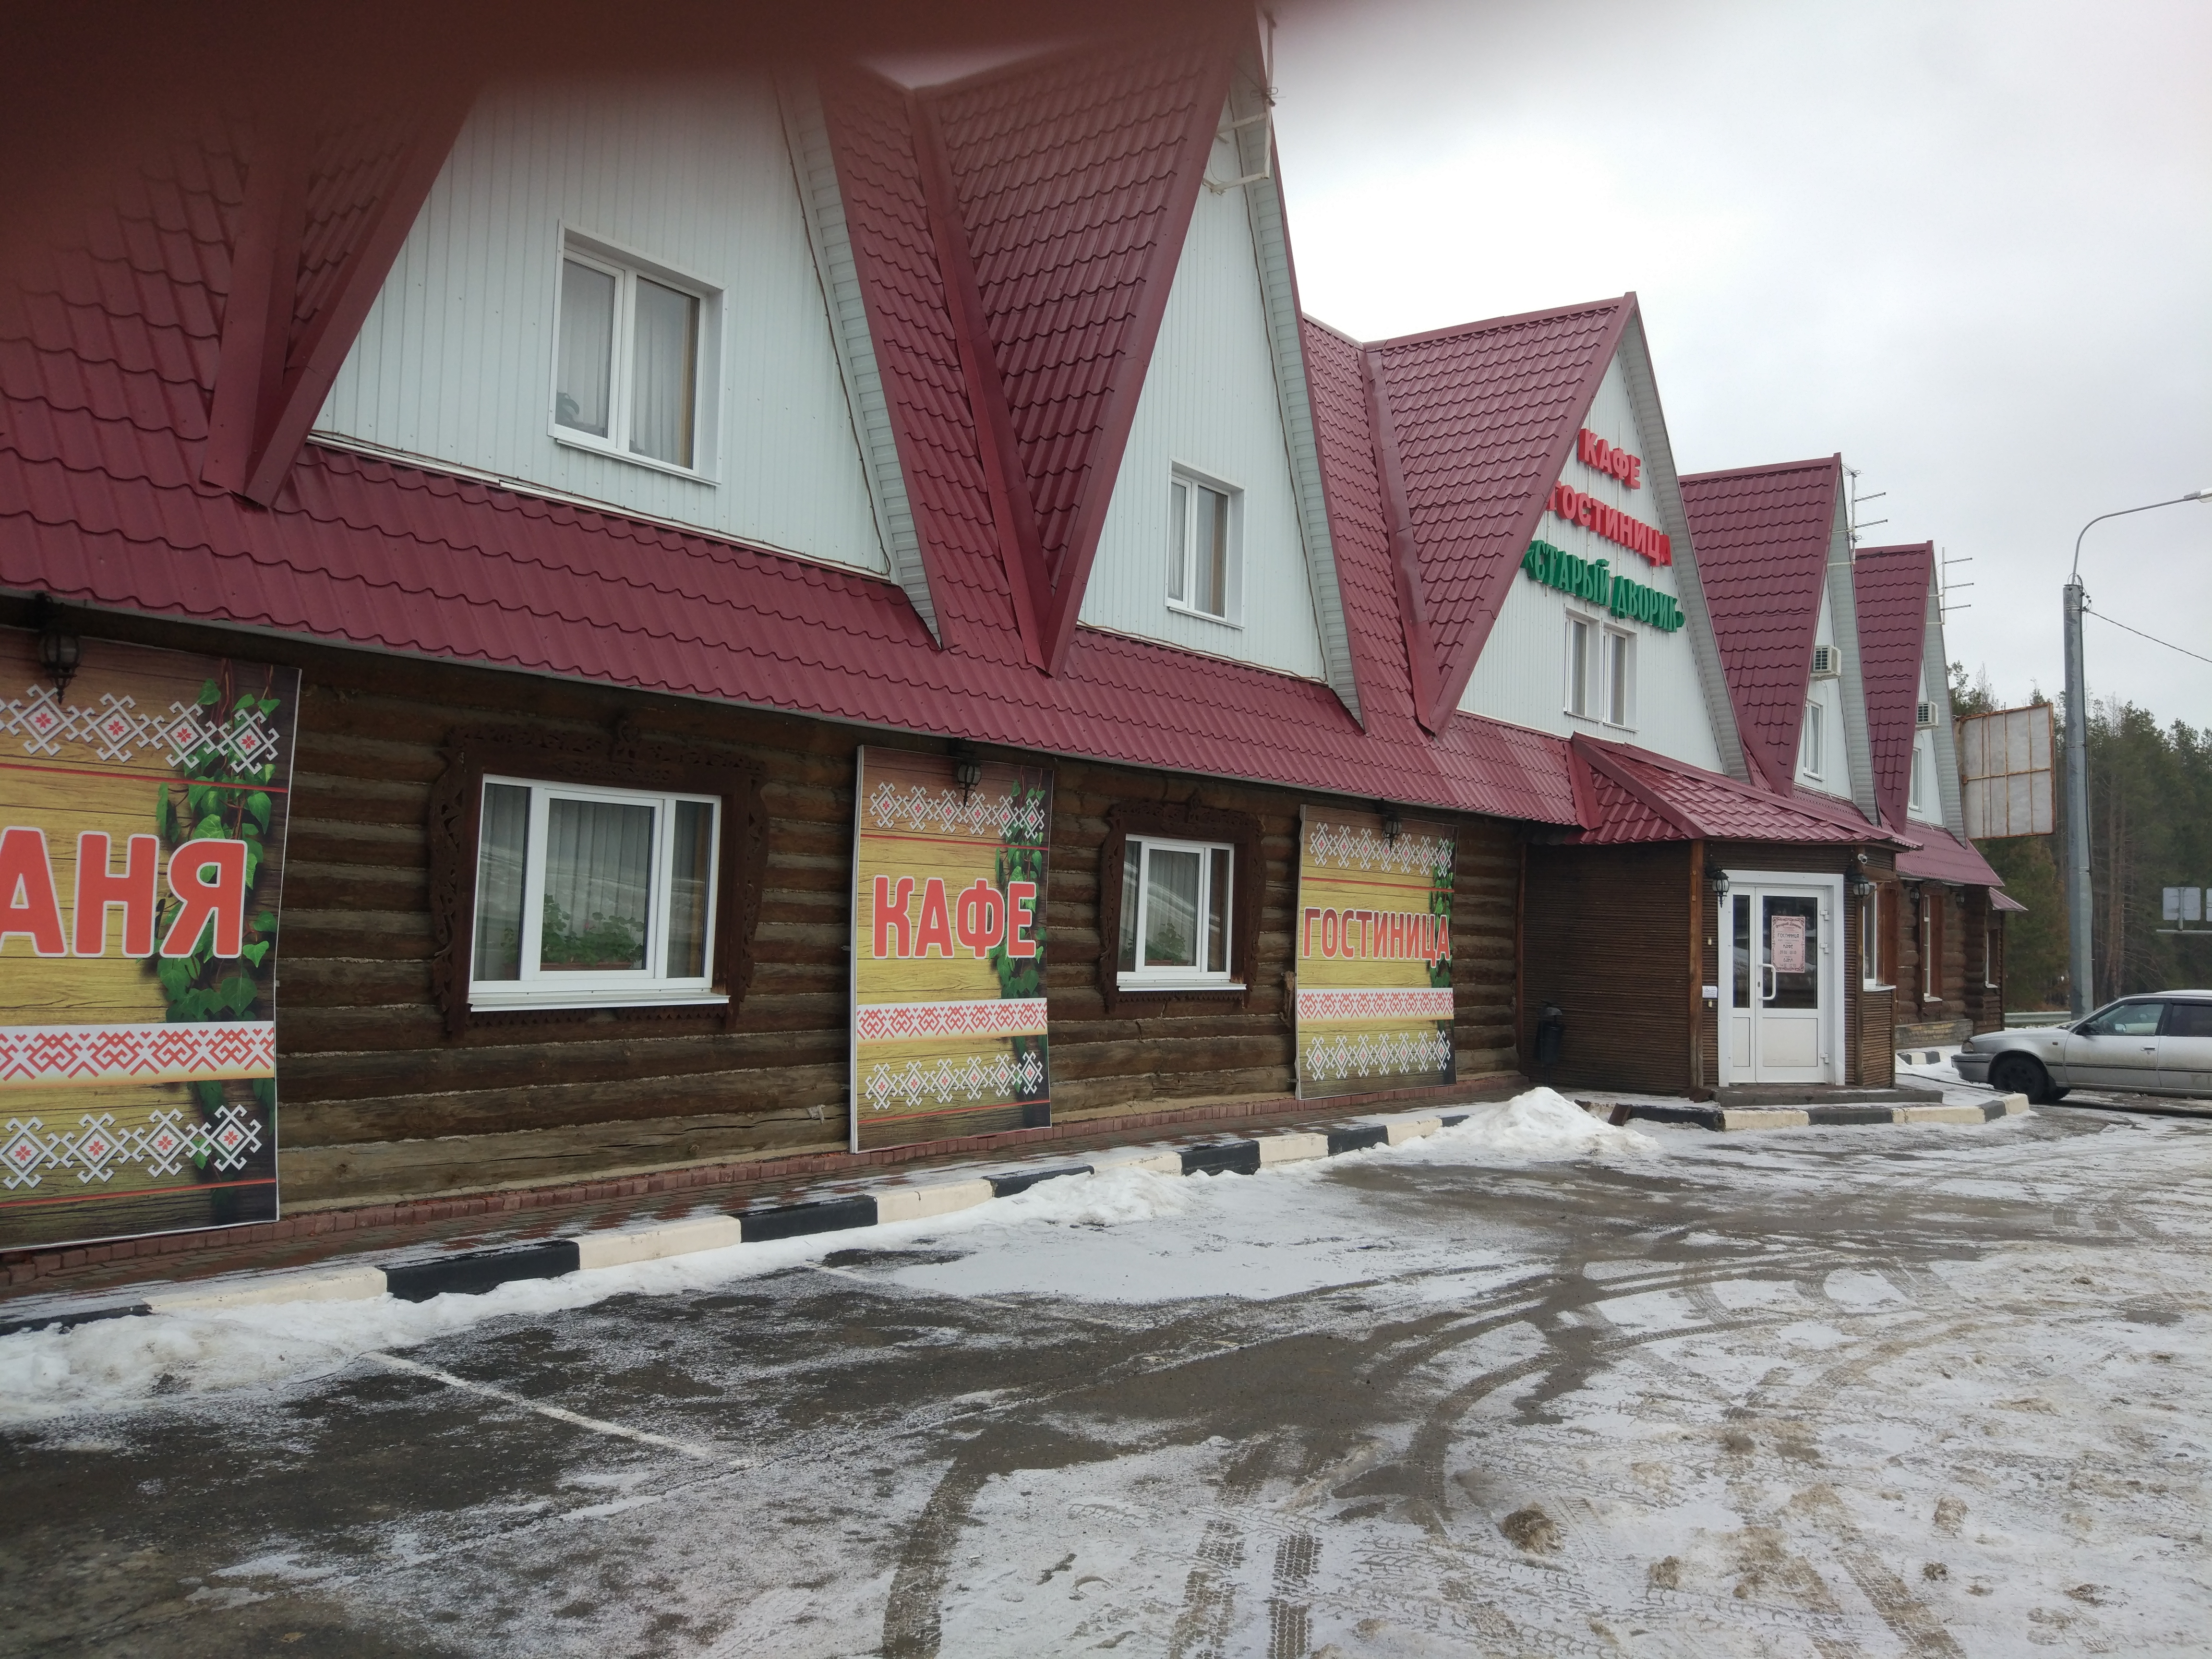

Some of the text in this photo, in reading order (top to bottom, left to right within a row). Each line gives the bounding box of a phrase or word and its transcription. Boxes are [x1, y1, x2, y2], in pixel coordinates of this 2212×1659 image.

[1578, 428, 1641, 490] КАФЕ
[1546, 480, 1672, 567] ГОСТИНИЦА
[1611, 576, 1685, 633] ДВОРИК
[873, 875, 1036, 959] КАФЕ
[1302, 907, 1451, 968] ГОСТИНИЦА
